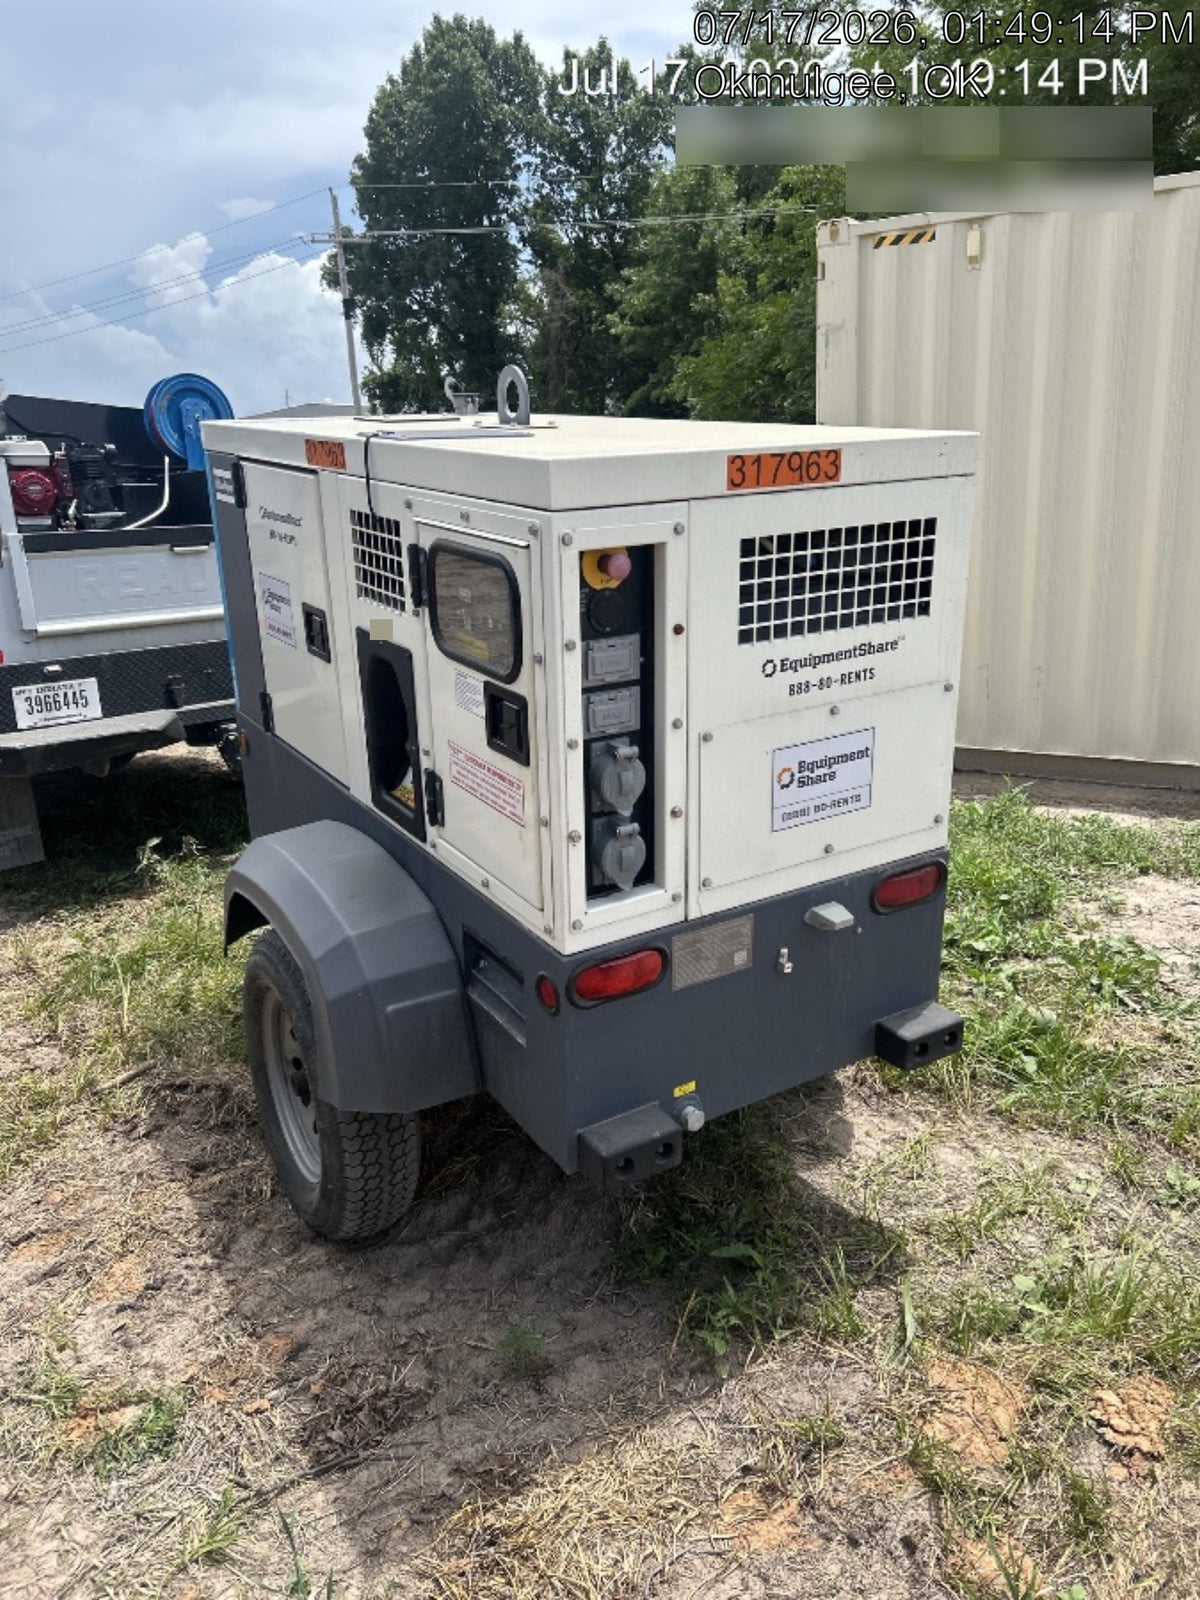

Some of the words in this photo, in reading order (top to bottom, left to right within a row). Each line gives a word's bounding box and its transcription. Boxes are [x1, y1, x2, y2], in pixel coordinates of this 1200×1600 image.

[730, 449, 839, 488] 317963
[779, 639, 899, 673] EquipmentShare
[788, 667, 876, 697] 888-80-RENTS
[24, 689, 89, 715] 3966445
[797, 745, 870, 774] Equipment
[796, 770, 837, 788] Share
